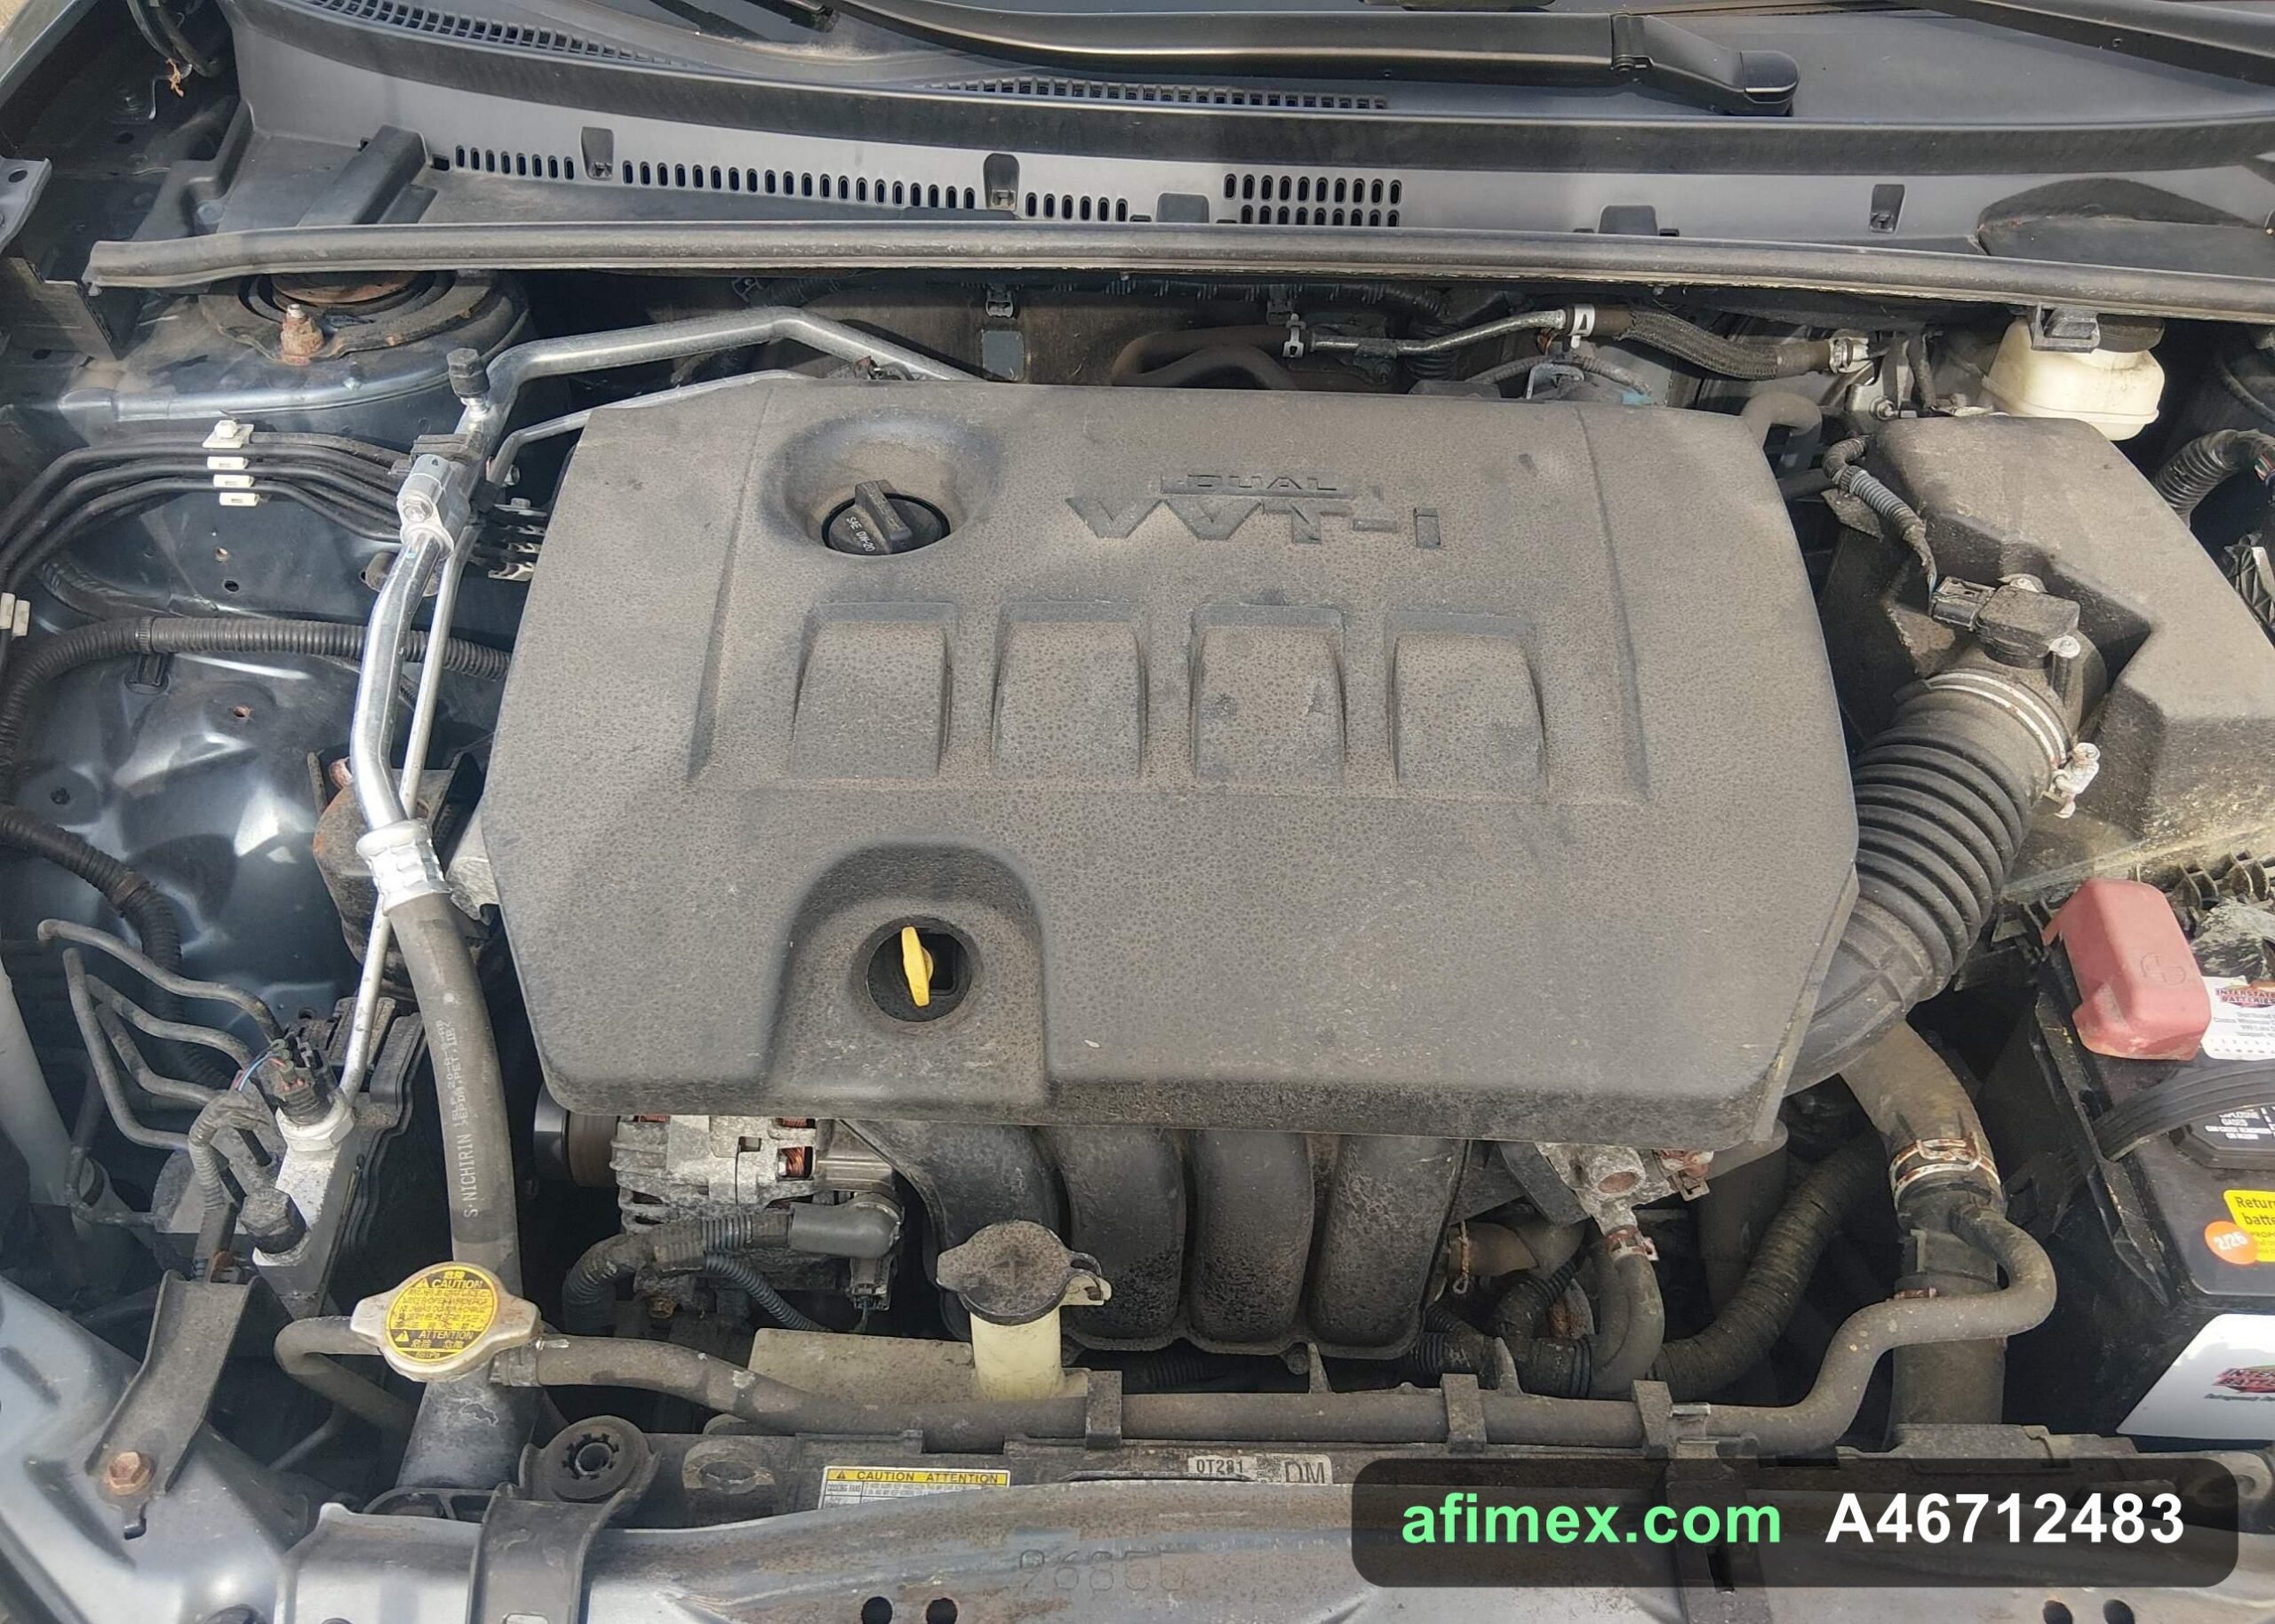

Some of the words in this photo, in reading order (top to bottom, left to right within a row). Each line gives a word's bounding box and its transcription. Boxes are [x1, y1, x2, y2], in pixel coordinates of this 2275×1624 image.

[1186, 474, 1337, 490] DUAL
[846, 516, 862, 530] SAE
[856, 530, 875, 552] 0W-20
[431, 1279, 483, 1289] CAUTION
[419, 1330, 474, 1340] ATTENTION
[857, 1471, 914, 1481] CAUTION
[926, 1473, 998, 1484] ATTENTION
[1285, 1461, 1325, 1484] DM
